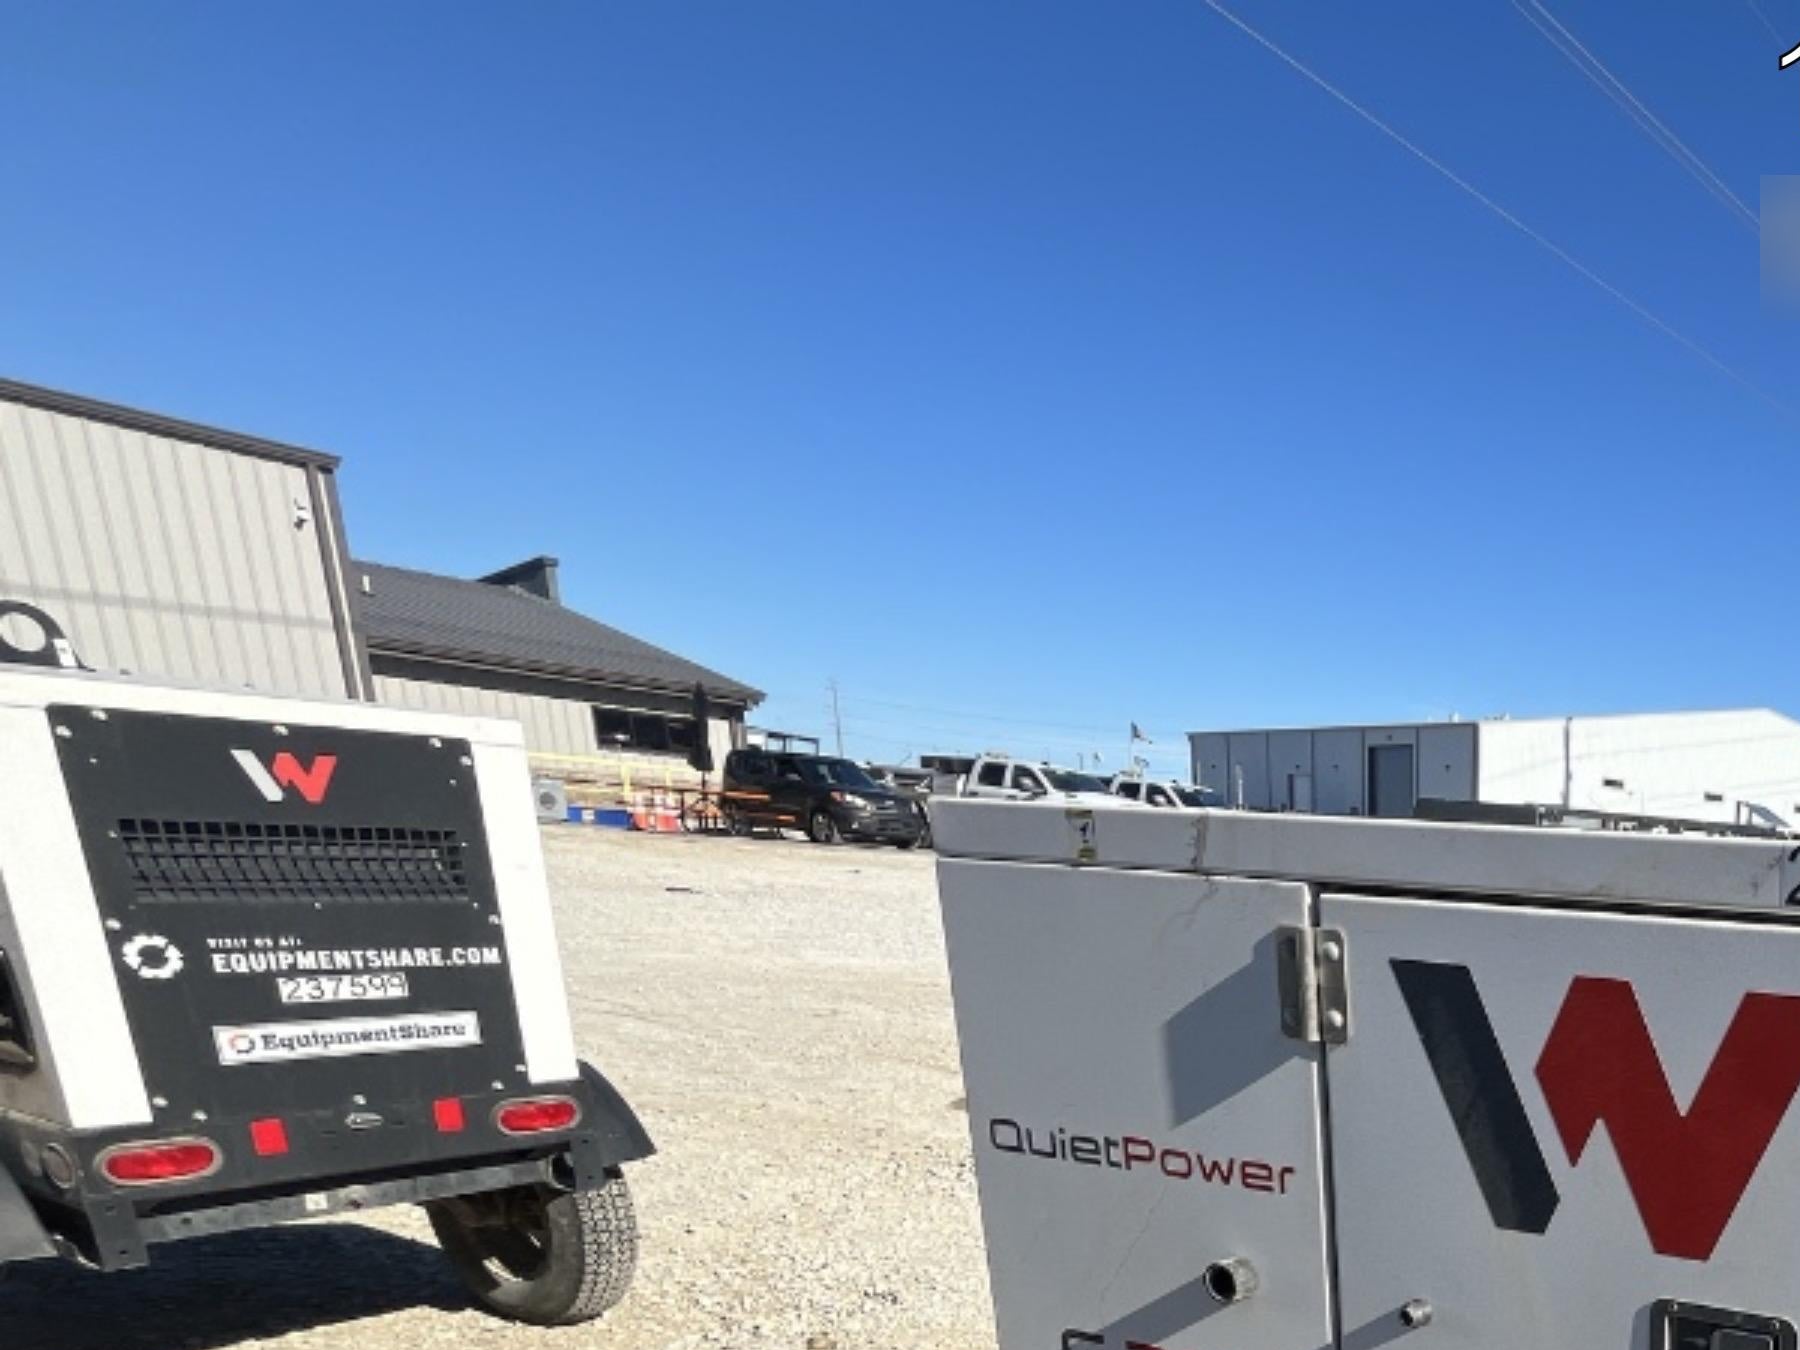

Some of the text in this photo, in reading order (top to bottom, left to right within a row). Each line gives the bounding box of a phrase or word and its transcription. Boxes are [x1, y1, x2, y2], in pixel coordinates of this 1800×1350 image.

[210, 947, 502, 974] EQUIPMENTSHARE.COM
[260, 1022, 467, 1052] EquipmentShare
[988, 1117, 1297, 1195] QuietPower
